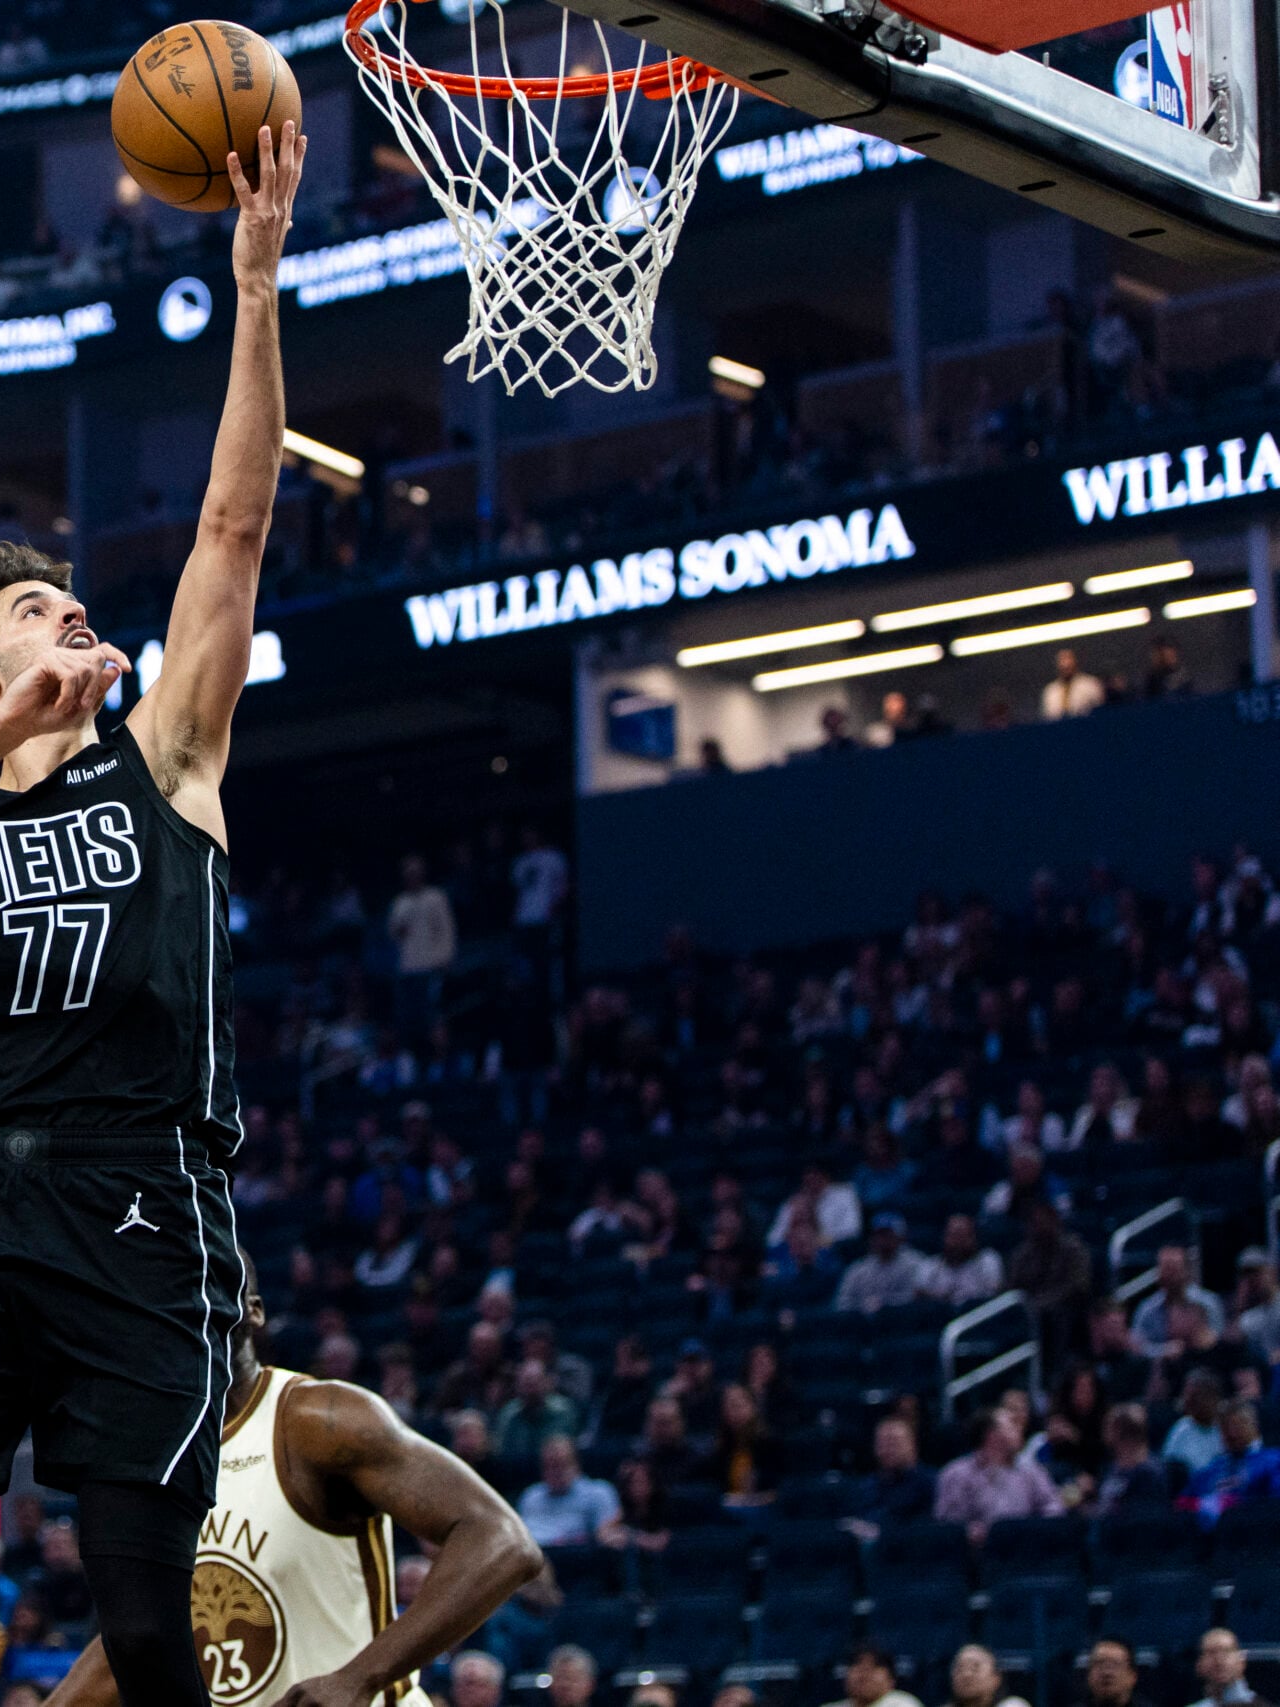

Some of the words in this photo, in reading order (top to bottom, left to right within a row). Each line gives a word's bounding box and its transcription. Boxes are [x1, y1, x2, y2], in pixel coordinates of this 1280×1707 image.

[1156, 80, 1179, 119] NBA
[405, 548, 676, 649] WILLIAMS
[679, 503, 916, 599] SONOMA
[66, 769, 82, 784] All
[81, 768, 95, 781] In
[93, 758, 118, 776] Won
[3, 903, 110, 1016] 77
[199, 1510, 269, 1562] WN
[204, 1638, 252, 1693] 23
